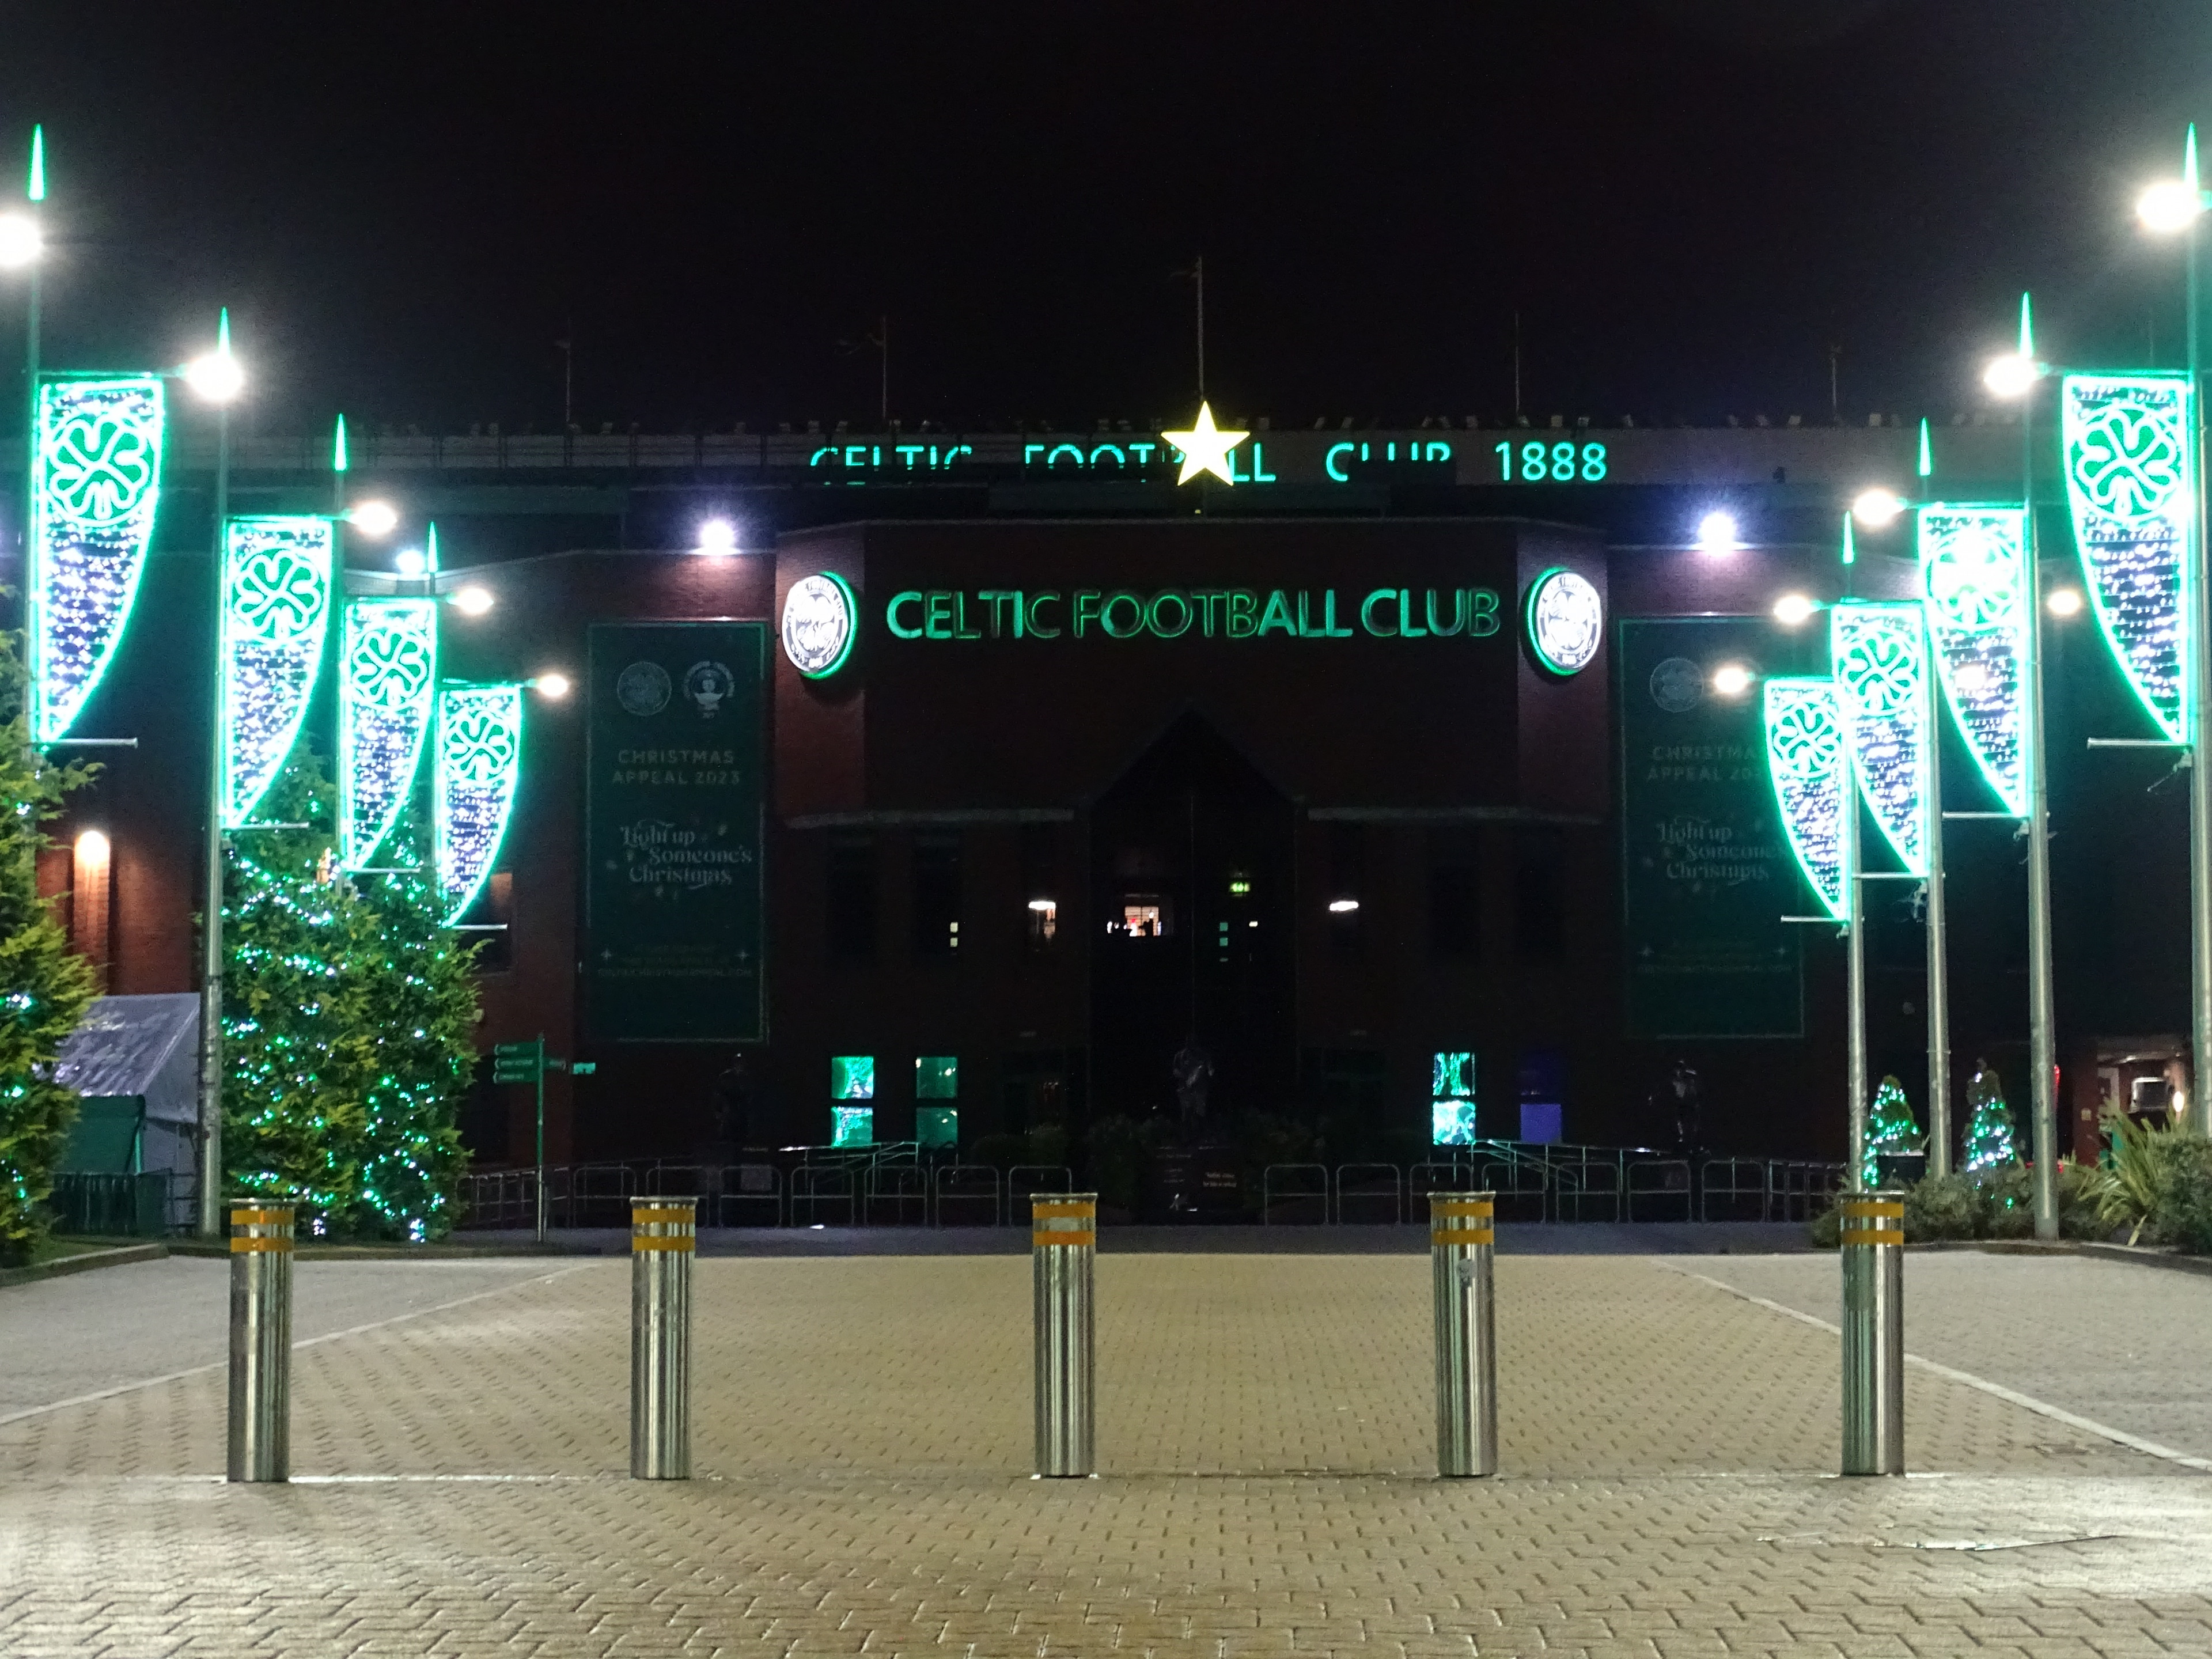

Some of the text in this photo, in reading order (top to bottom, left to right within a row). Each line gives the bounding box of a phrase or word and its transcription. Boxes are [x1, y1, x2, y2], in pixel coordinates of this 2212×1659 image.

[1025, 442, 1277, 483] FOOTLL
[1495, 442, 1607, 482] 1888
[886, 590, 1061, 639] CELTIC
[1073, 589, 1354, 639] FOOTBALL
[1361, 588, 1501, 638] CLUB
[618, 749, 734, 764] CHRISTMAS
[1652, 746, 1765, 761] CHRISTMA
[612, 770, 741, 785] APPEAL 2023
